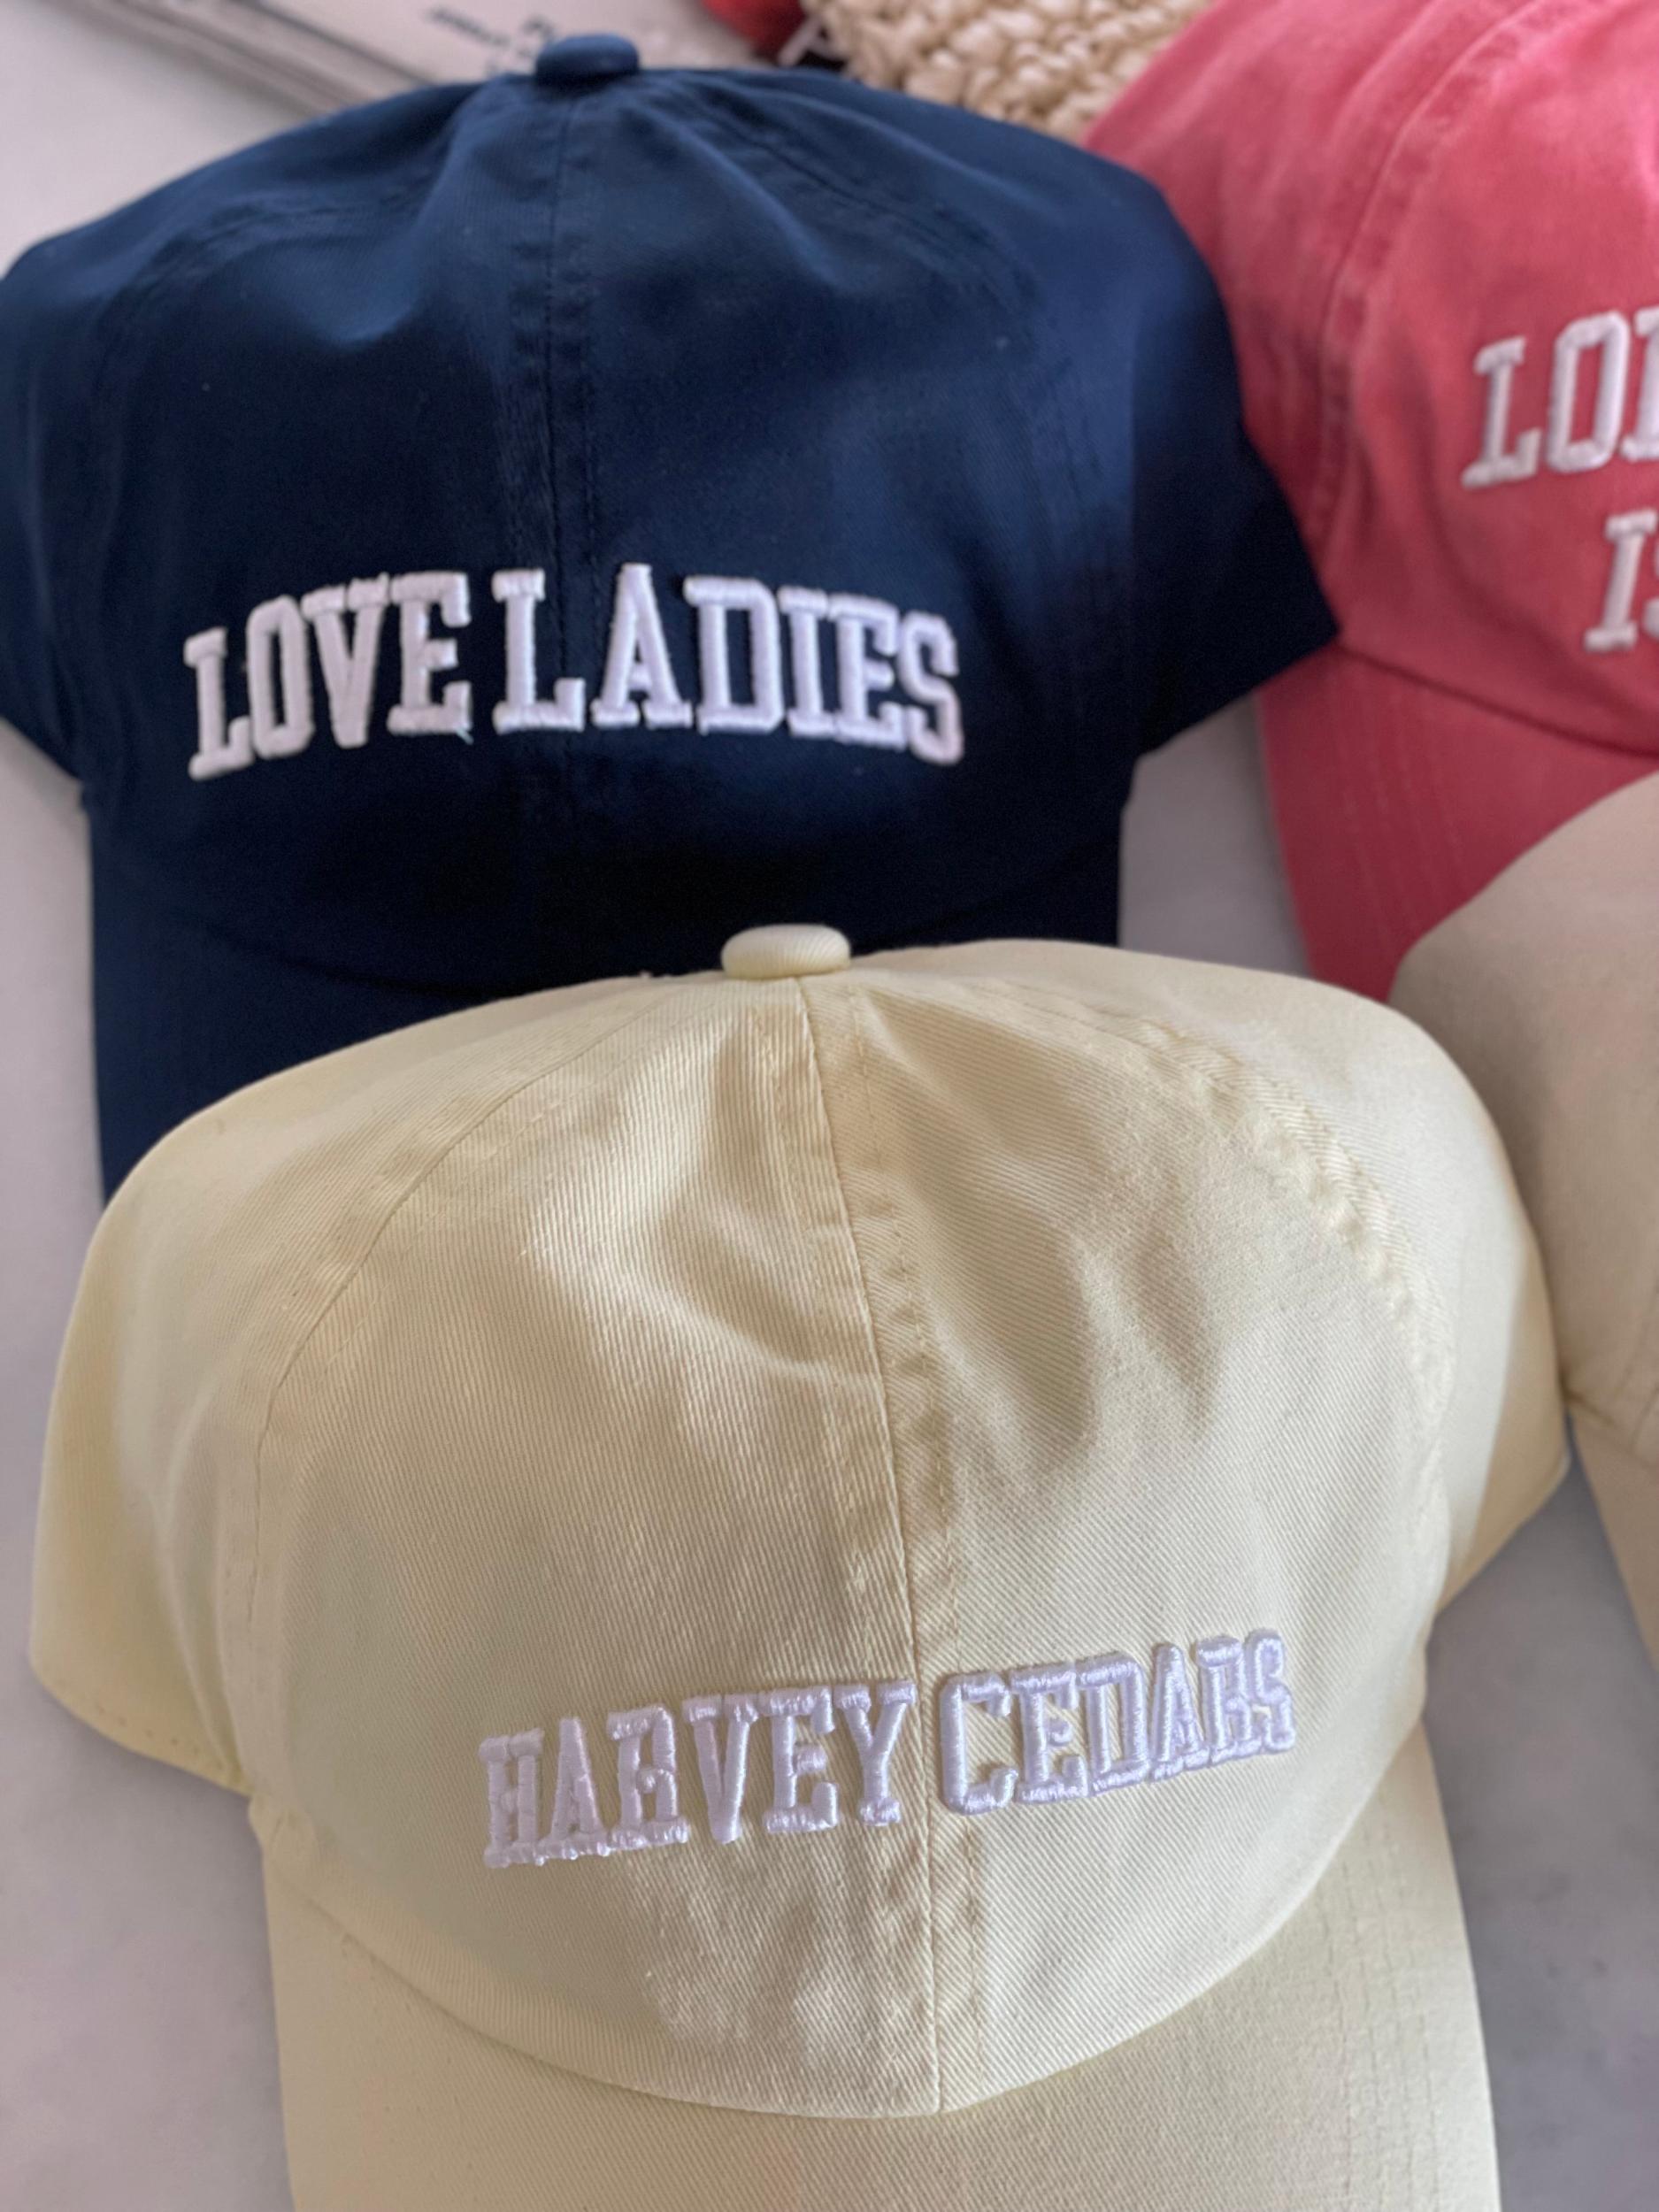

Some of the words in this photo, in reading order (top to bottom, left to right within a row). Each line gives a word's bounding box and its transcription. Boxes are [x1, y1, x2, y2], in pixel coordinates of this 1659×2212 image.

[184, 572, 471, 780] LOVE
[492, 563, 964, 764] LADIES
[1583, 507, 1659, 653] I
[479, 1679, 917, 1867] HARVEY
[939, 1627, 1295, 1816] CEDARS
